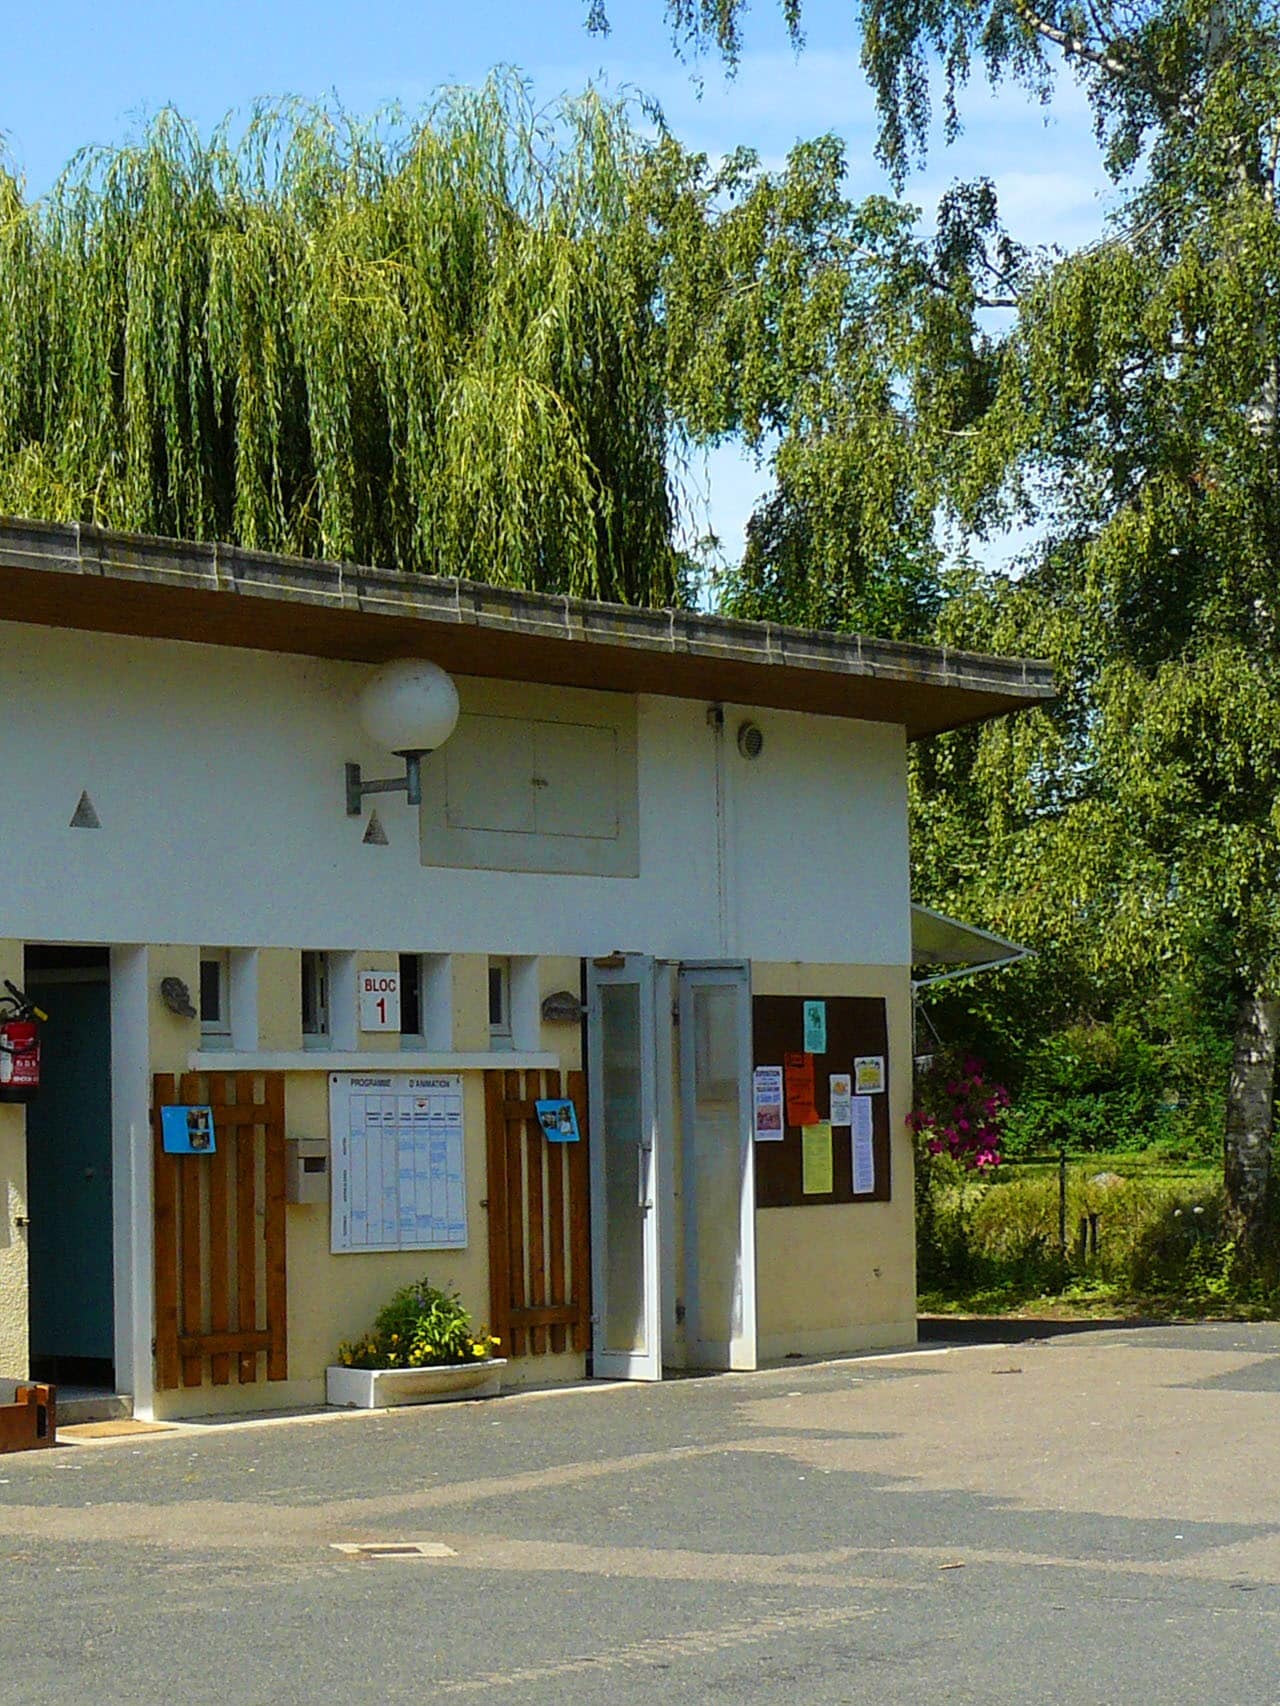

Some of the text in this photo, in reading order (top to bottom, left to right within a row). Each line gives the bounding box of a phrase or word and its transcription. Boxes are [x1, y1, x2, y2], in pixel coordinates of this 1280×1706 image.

[365, 978, 396, 993] BLOC
[376, 997, 386, 1024] 1
[350, 1078, 450, 1089] PROGRAMME D'ANIMATION
